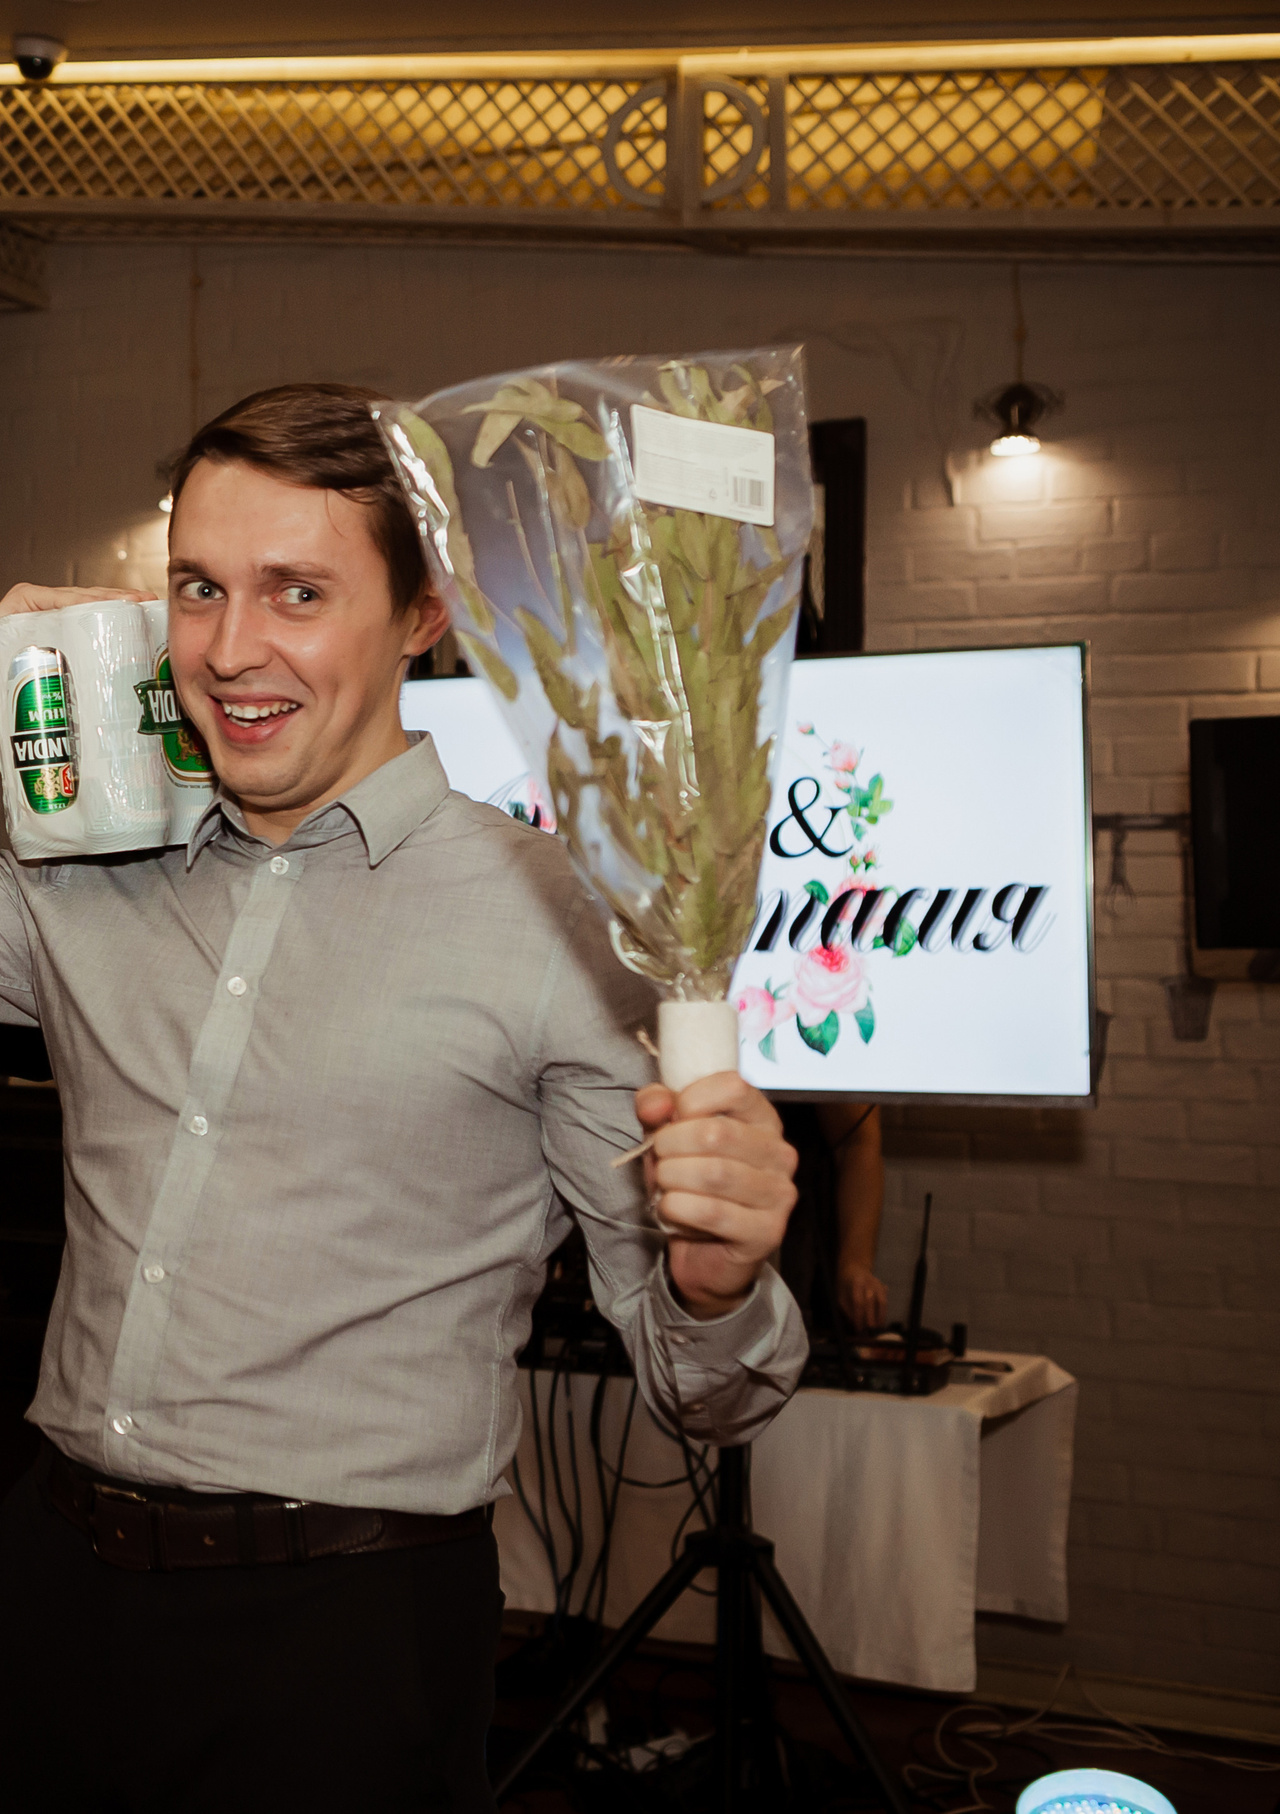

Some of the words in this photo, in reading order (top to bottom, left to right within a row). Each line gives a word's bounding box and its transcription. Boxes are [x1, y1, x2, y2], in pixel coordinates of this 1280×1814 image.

[147, 690, 181, 723] DIA
[769, 776, 853, 858] &
[753, 882, 1056, 953] тасия
